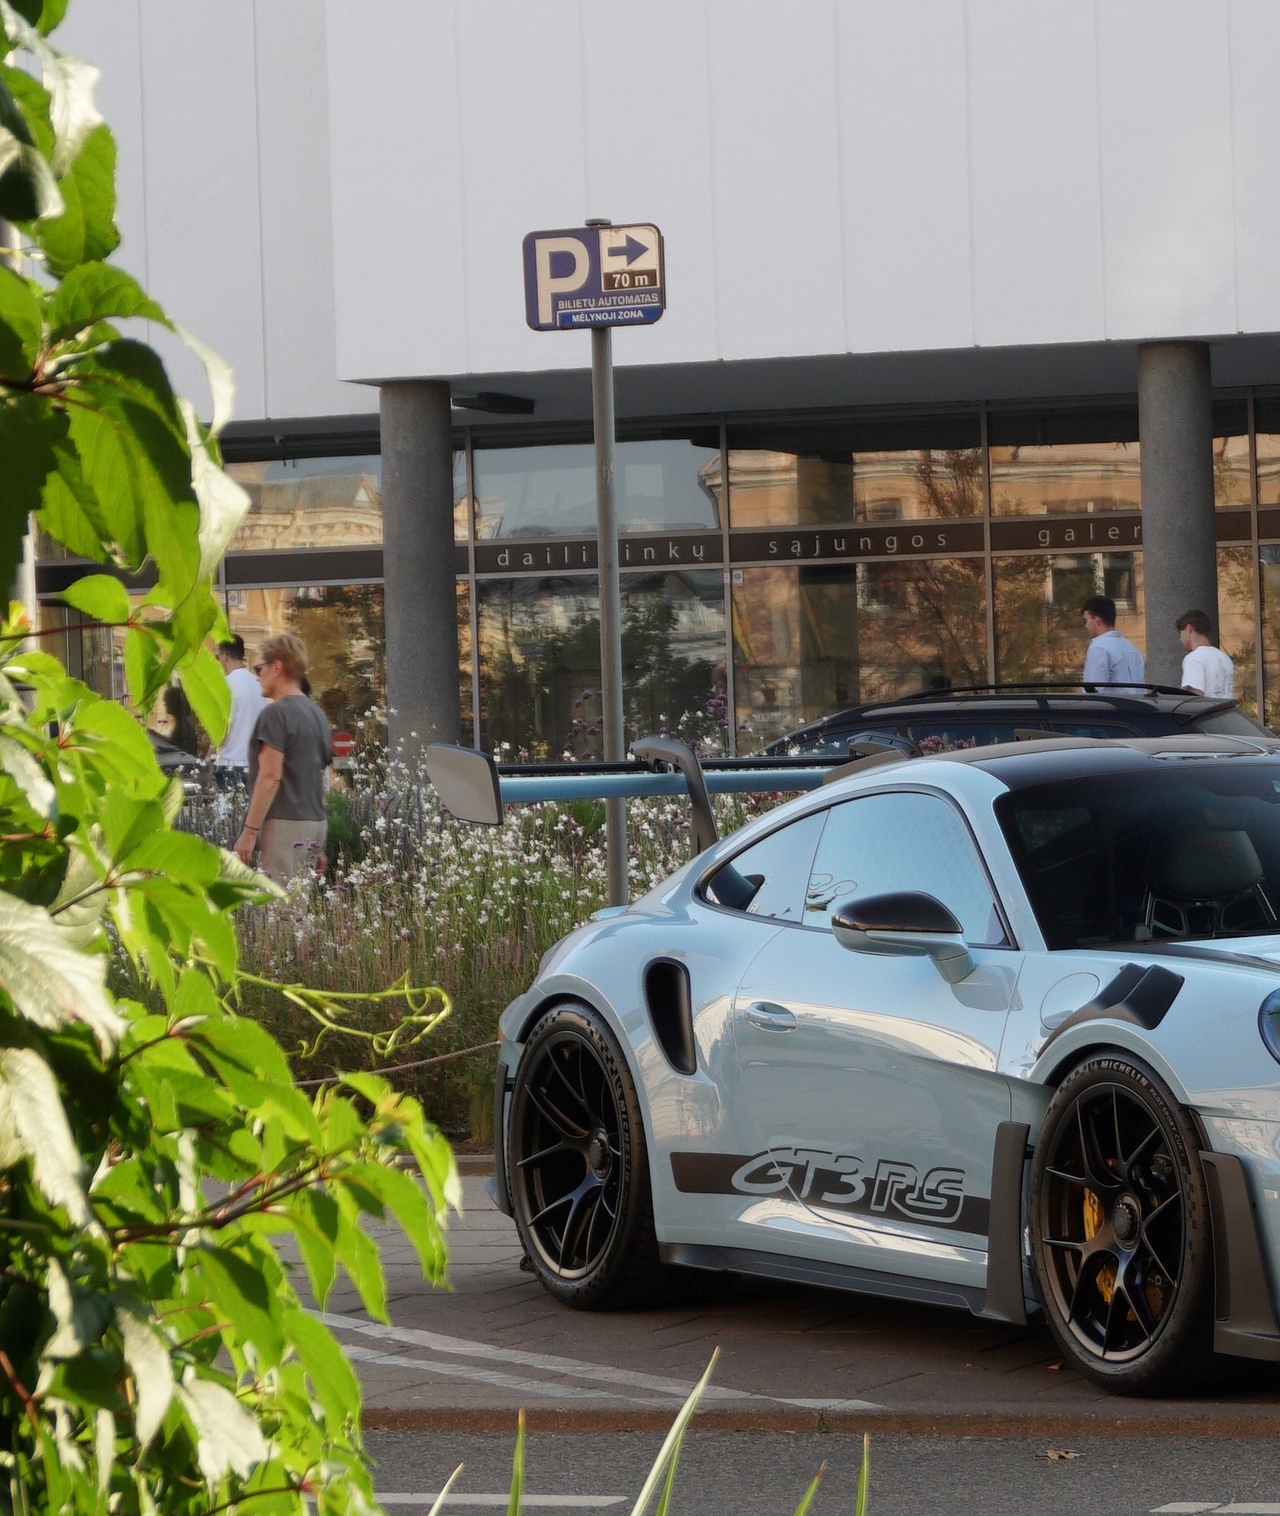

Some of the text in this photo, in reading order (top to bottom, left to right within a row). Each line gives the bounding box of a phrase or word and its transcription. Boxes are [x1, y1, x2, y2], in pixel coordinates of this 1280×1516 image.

[534, 236, 590, 325] P
[612, 273, 649, 288] 70 m
[558, 293, 659, 310] BILIETŲ AUTOMATAS
[571, 309, 644, 323] MĖLYNOJI ZONA
[497, 541, 705, 567] dailiinkų
[768, 530, 947, 557] sąjungos
[1100, 1060, 1149, 1087] MICHELIN
[1162, 1107, 1177, 1132] SPORT
[618, 1098, 632, 1185] MICHELIN
